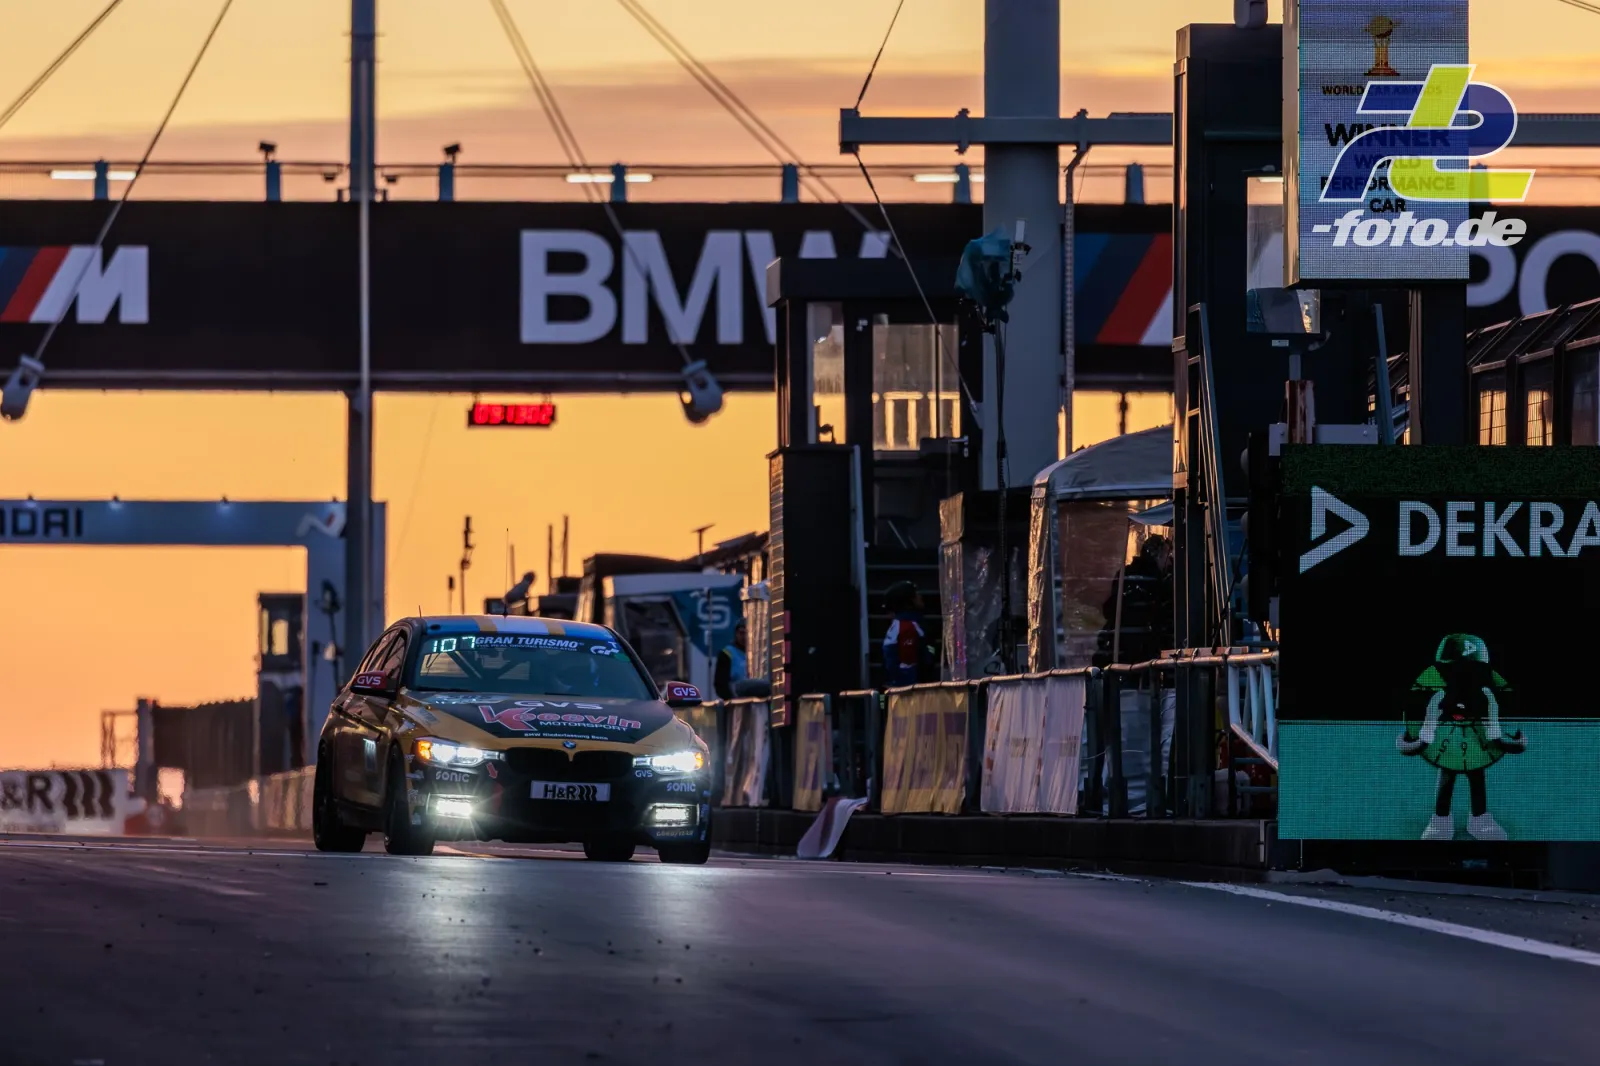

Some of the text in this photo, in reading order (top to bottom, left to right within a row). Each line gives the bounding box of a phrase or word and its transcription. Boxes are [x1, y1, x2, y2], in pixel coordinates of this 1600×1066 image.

[1321, 86, 1364, 95] WORLD
[1324, 123, 1450, 147] WINNER
[1320, 176, 1455, 191] PERFORMANCE
[1369, 198, 1406, 213] CAR
[0, 507, 83, 537] DAI
[1398, 501, 1600, 557] DEKRA
[433, 636, 476, 652] 107
[475, 636, 579, 649] GRAN TURISMO
[356, 675, 382, 686] GVS
[673, 687, 697, 697] GVS
[514, 700, 603, 710] GVS
[539, 721, 628, 732] MOTORSPORT
[635, 769, 653, 778] GVS
[543, 783, 577, 800] H&R
